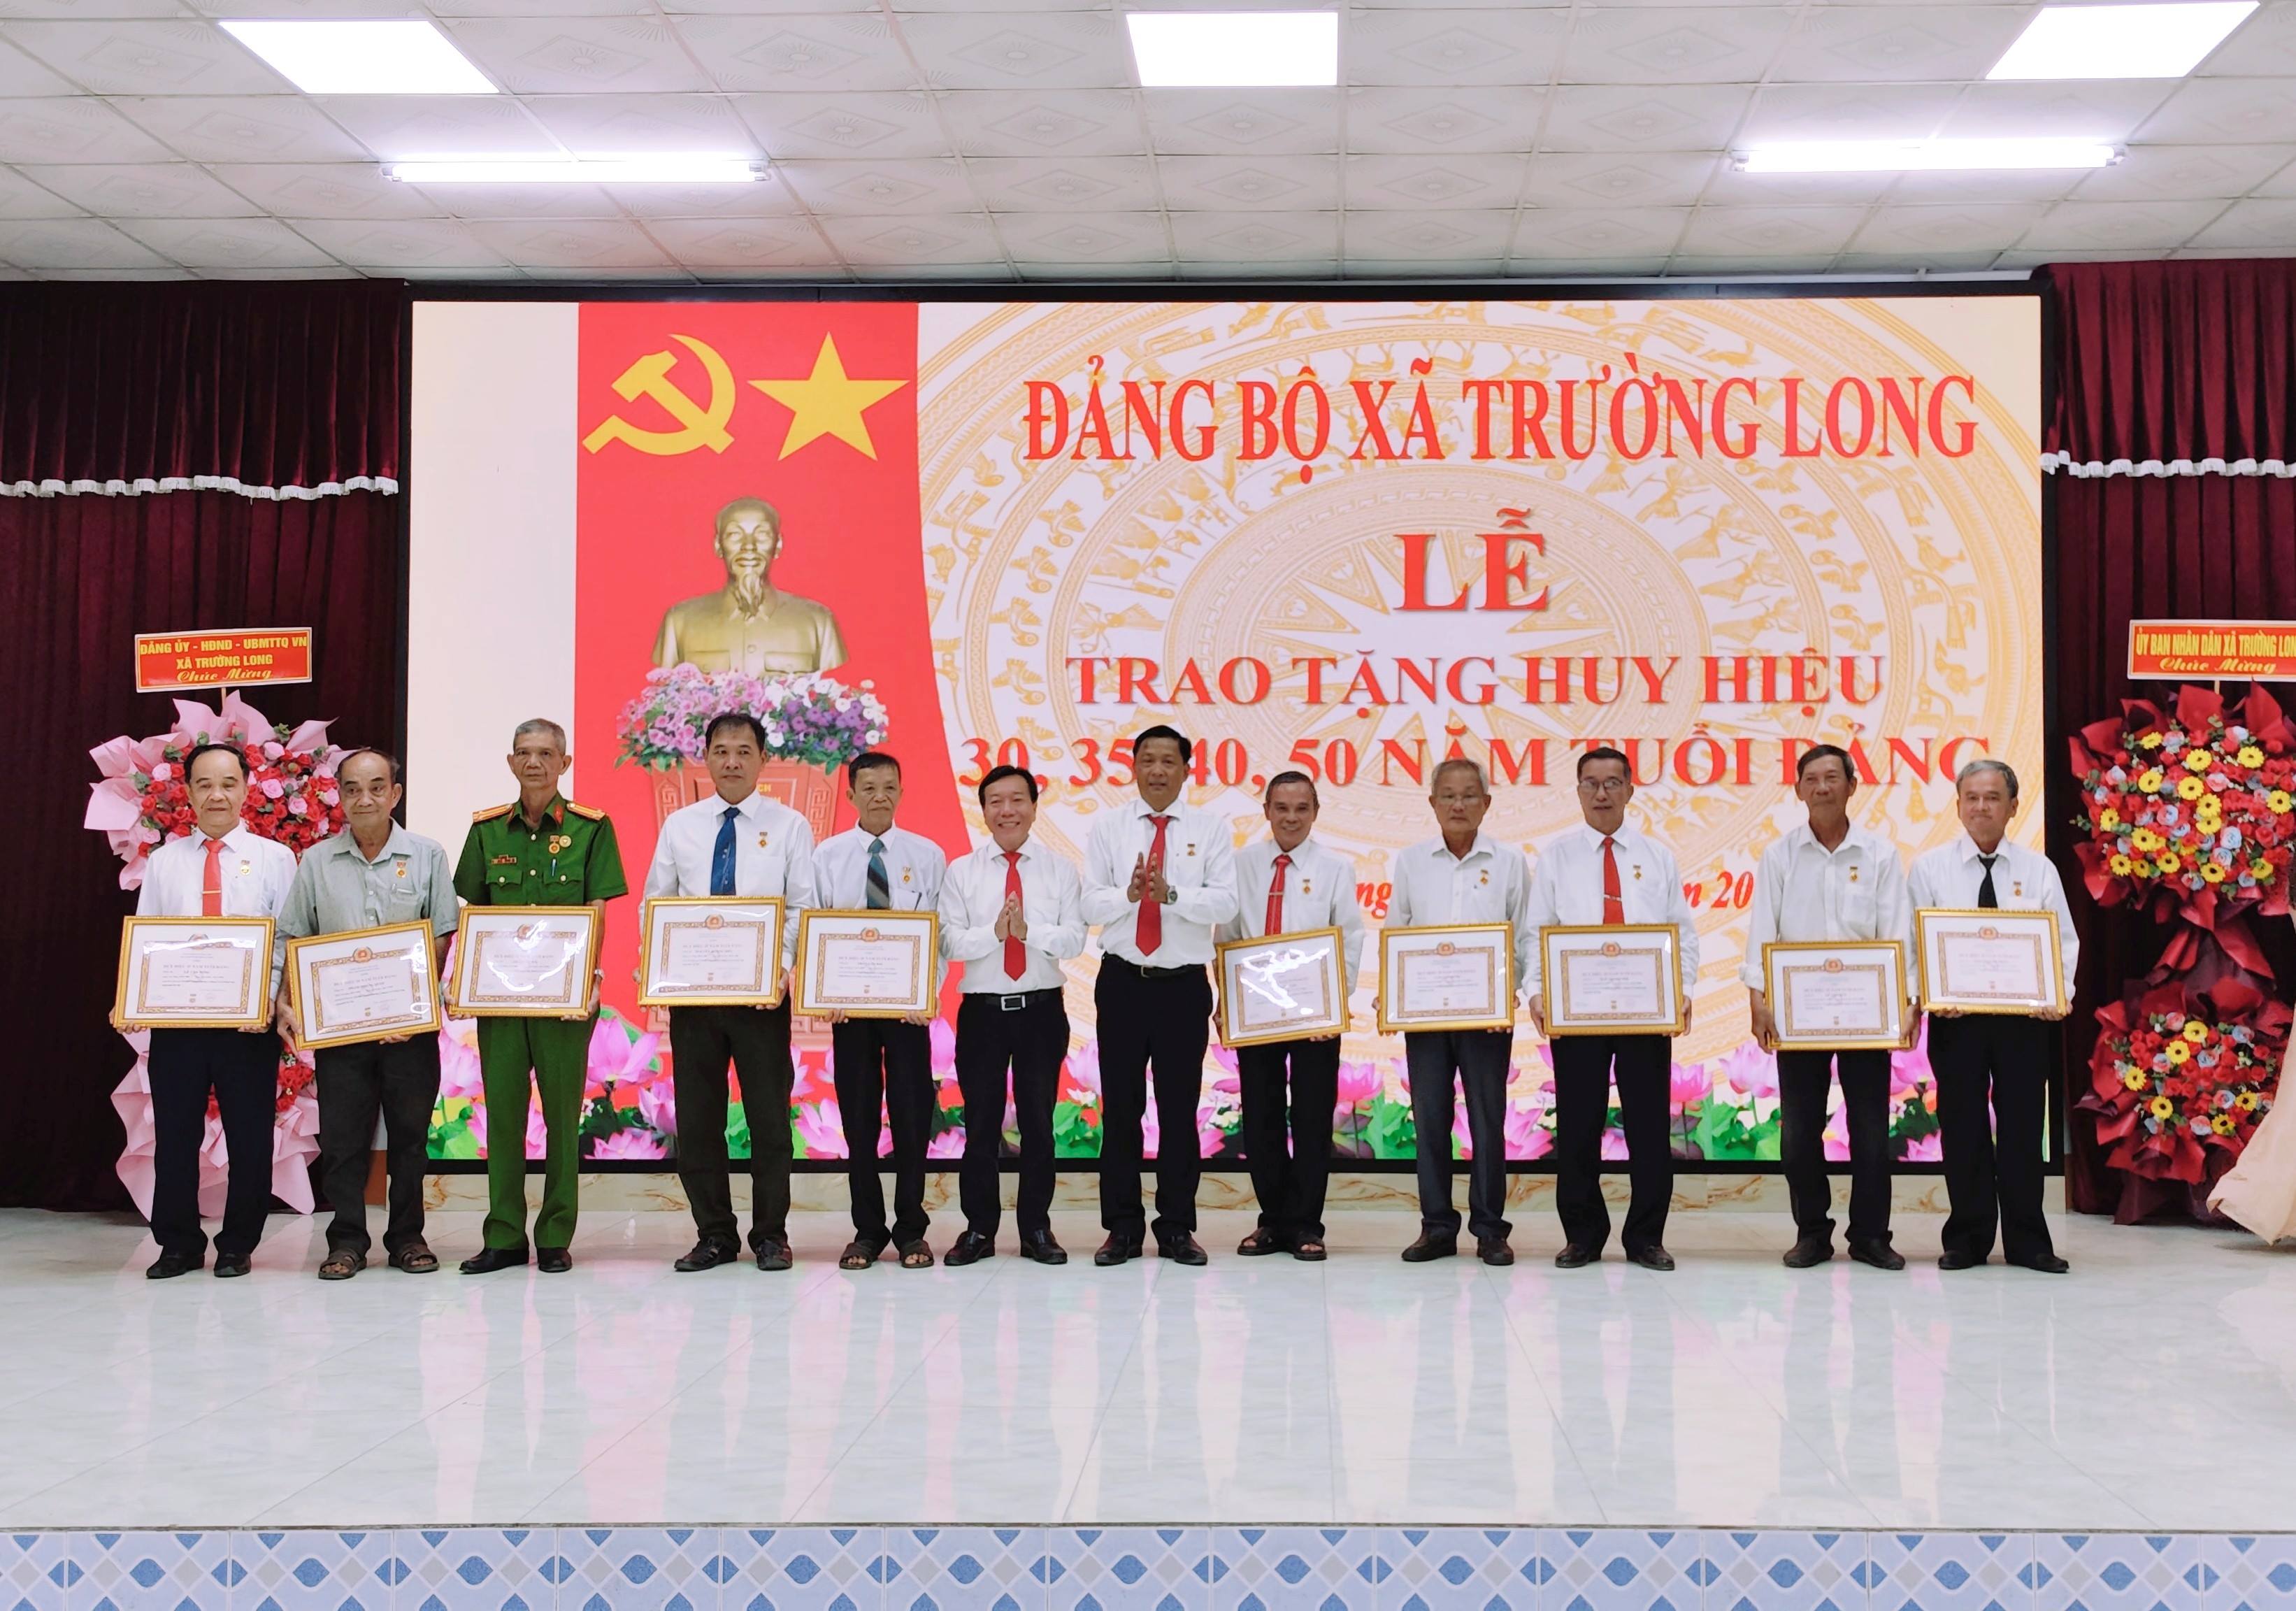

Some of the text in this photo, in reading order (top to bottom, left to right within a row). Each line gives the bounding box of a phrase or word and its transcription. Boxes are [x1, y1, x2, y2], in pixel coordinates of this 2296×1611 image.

[1023, 352, 1978, 485] ĐẢNG BỘ XÃ TRƯỜNG LONG
[1393, 508, 1549, 611] LỄ
[140, 640, 172, 655] ĐẢNG
[175, 639, 190, 653] ỦY
[201, 639, 233, 652] HĐND
[243, 637, 289, 650] UBMTTQ
[292, 636, 307, 647] VN
[2151, 633, 2171, 656] BAN
[2239, 629, 2277, 657] TRƯỜNG
[2278, 635, 2296, 657] LON
[176, 654, 273, 670] XÃ TRƯỜNG LONG
[177, 668, 272, 683] Chúc Mừng
[2160, 657, 2209, 672] Chúc
[1065, 647, 1886, 719] TRAO TẶNG HUY HIỆU
[1289, 739, 1358, 787] 50
[1711, 871, 1754, 909] 20
